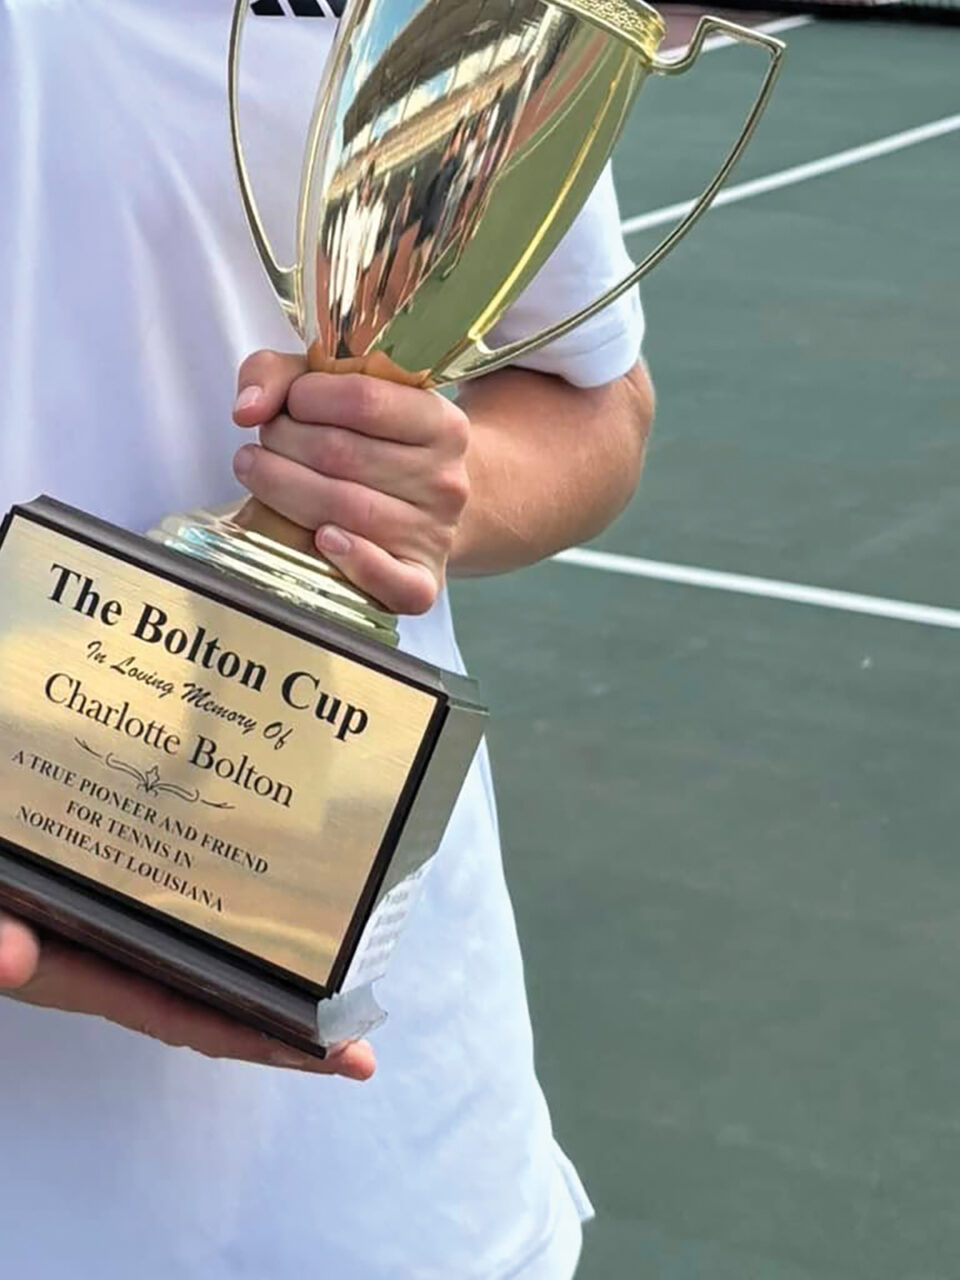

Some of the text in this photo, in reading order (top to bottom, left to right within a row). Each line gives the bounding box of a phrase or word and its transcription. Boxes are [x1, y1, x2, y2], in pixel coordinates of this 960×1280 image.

[48, 563, 369, 743] The Bolton Cup
[87, 640, 294, 751] In Loving Memory Of
[44, 672, 294, 808] Charlotte Bolton
[11, 749, 269, 874] A TRUE PIONEER AND FRIEND
[16, 805, 224, 913] NORTHEAST LOUISIANA
[66, 800, 195, 869] FOR TENNIS IN
